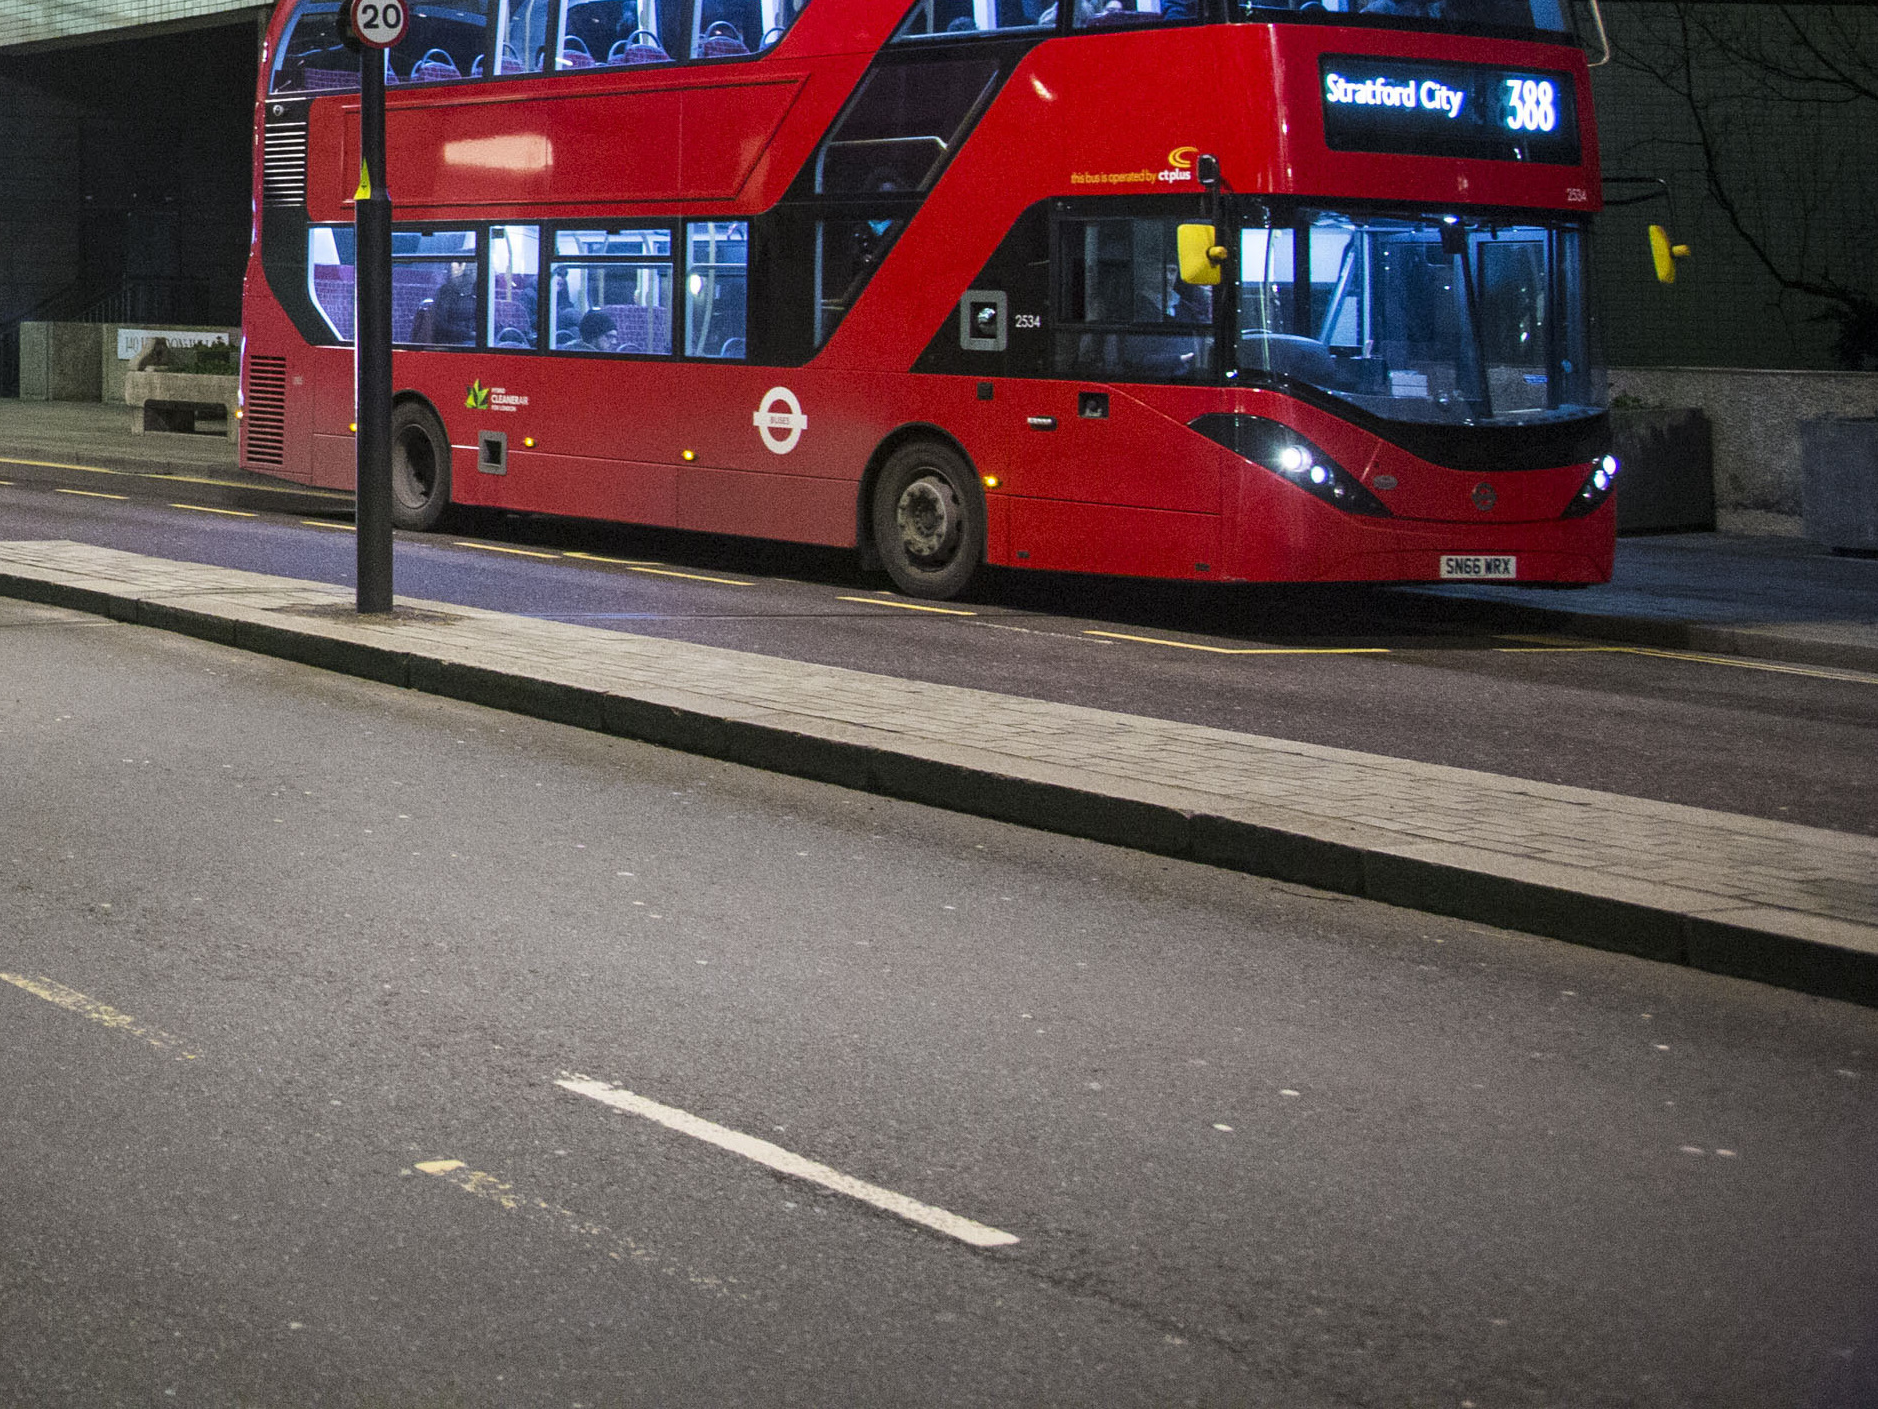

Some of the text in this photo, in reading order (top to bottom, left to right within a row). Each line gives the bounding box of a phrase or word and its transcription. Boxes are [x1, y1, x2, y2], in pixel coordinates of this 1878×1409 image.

[361, 3, 402, 30] 20
[1325, 72, 1557, 133] Stratford City 388
[1086, 171, 1100, 183] bus
[1108, 169, 1145, 185] operated
[1014, 314, 1041, 328] 2534
[1445, 557, 1512, 575] SN66 WRX
